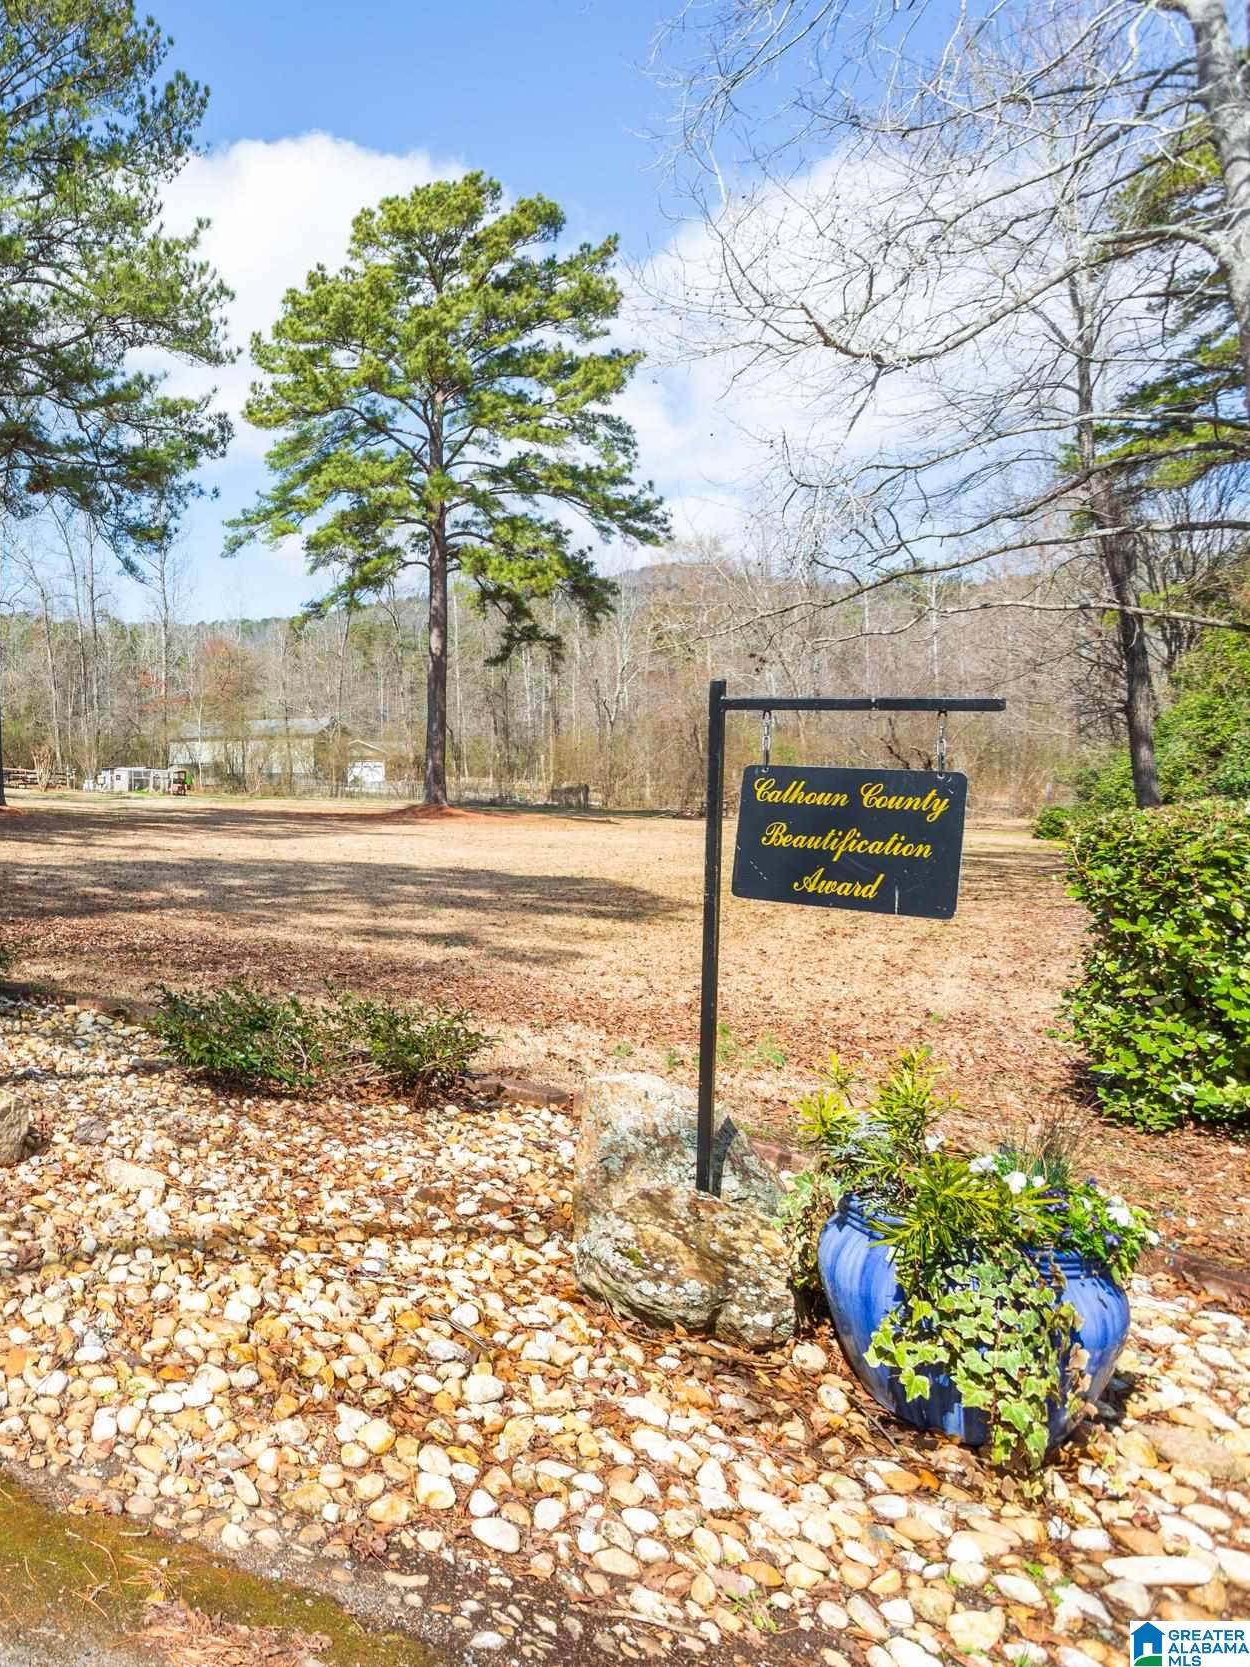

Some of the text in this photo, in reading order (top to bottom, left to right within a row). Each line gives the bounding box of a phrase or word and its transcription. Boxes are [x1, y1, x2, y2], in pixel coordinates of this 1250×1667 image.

[753, 777, 950, 822] Calhoun County
[761, 822, 933, 862] Beautification
[793, 865, 885, 899] Award
